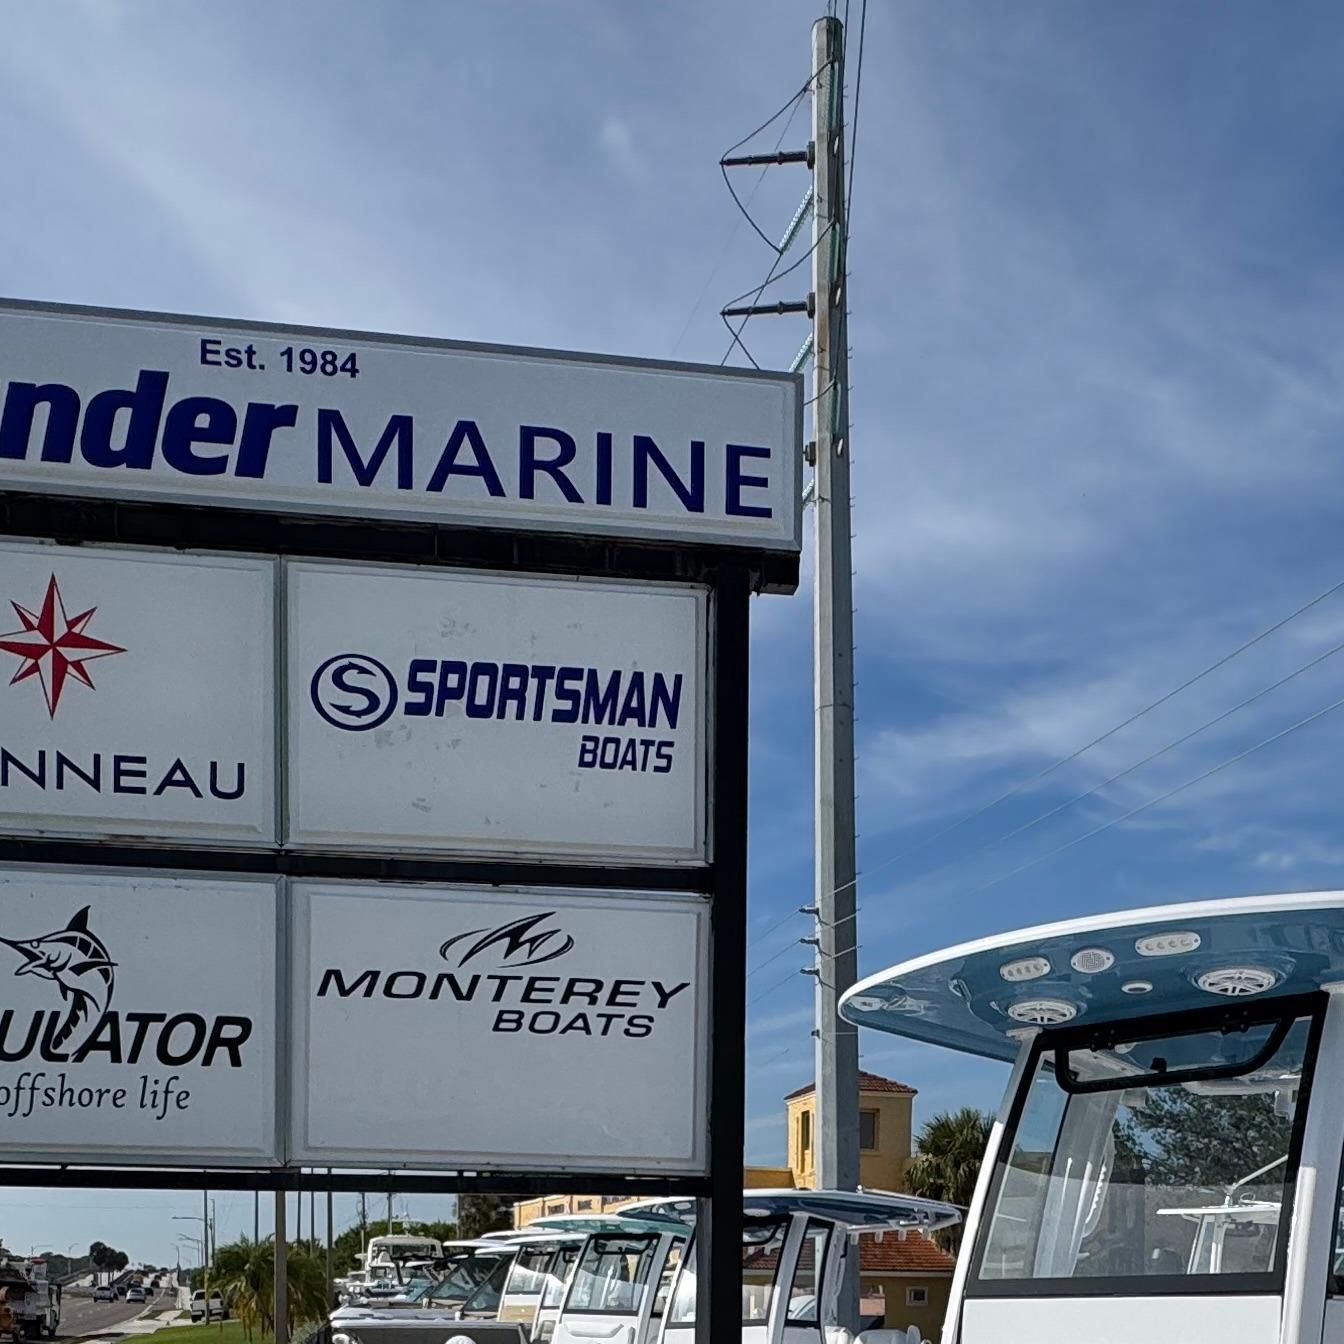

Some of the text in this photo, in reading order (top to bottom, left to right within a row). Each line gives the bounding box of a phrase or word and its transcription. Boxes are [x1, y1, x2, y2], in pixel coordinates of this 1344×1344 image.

[200, 338, 359, 379] Est. 1984
[317, 408, 773, 519] MARINE
[403, 658, 683, 730] SPORTSMAN
[577, 734, 675, 774] BOATS
[316, 967, 691, 1010] MONTEREY
[491, 1007, 655, 1039] BOATS
[139, 1075, 191, 1121] life
